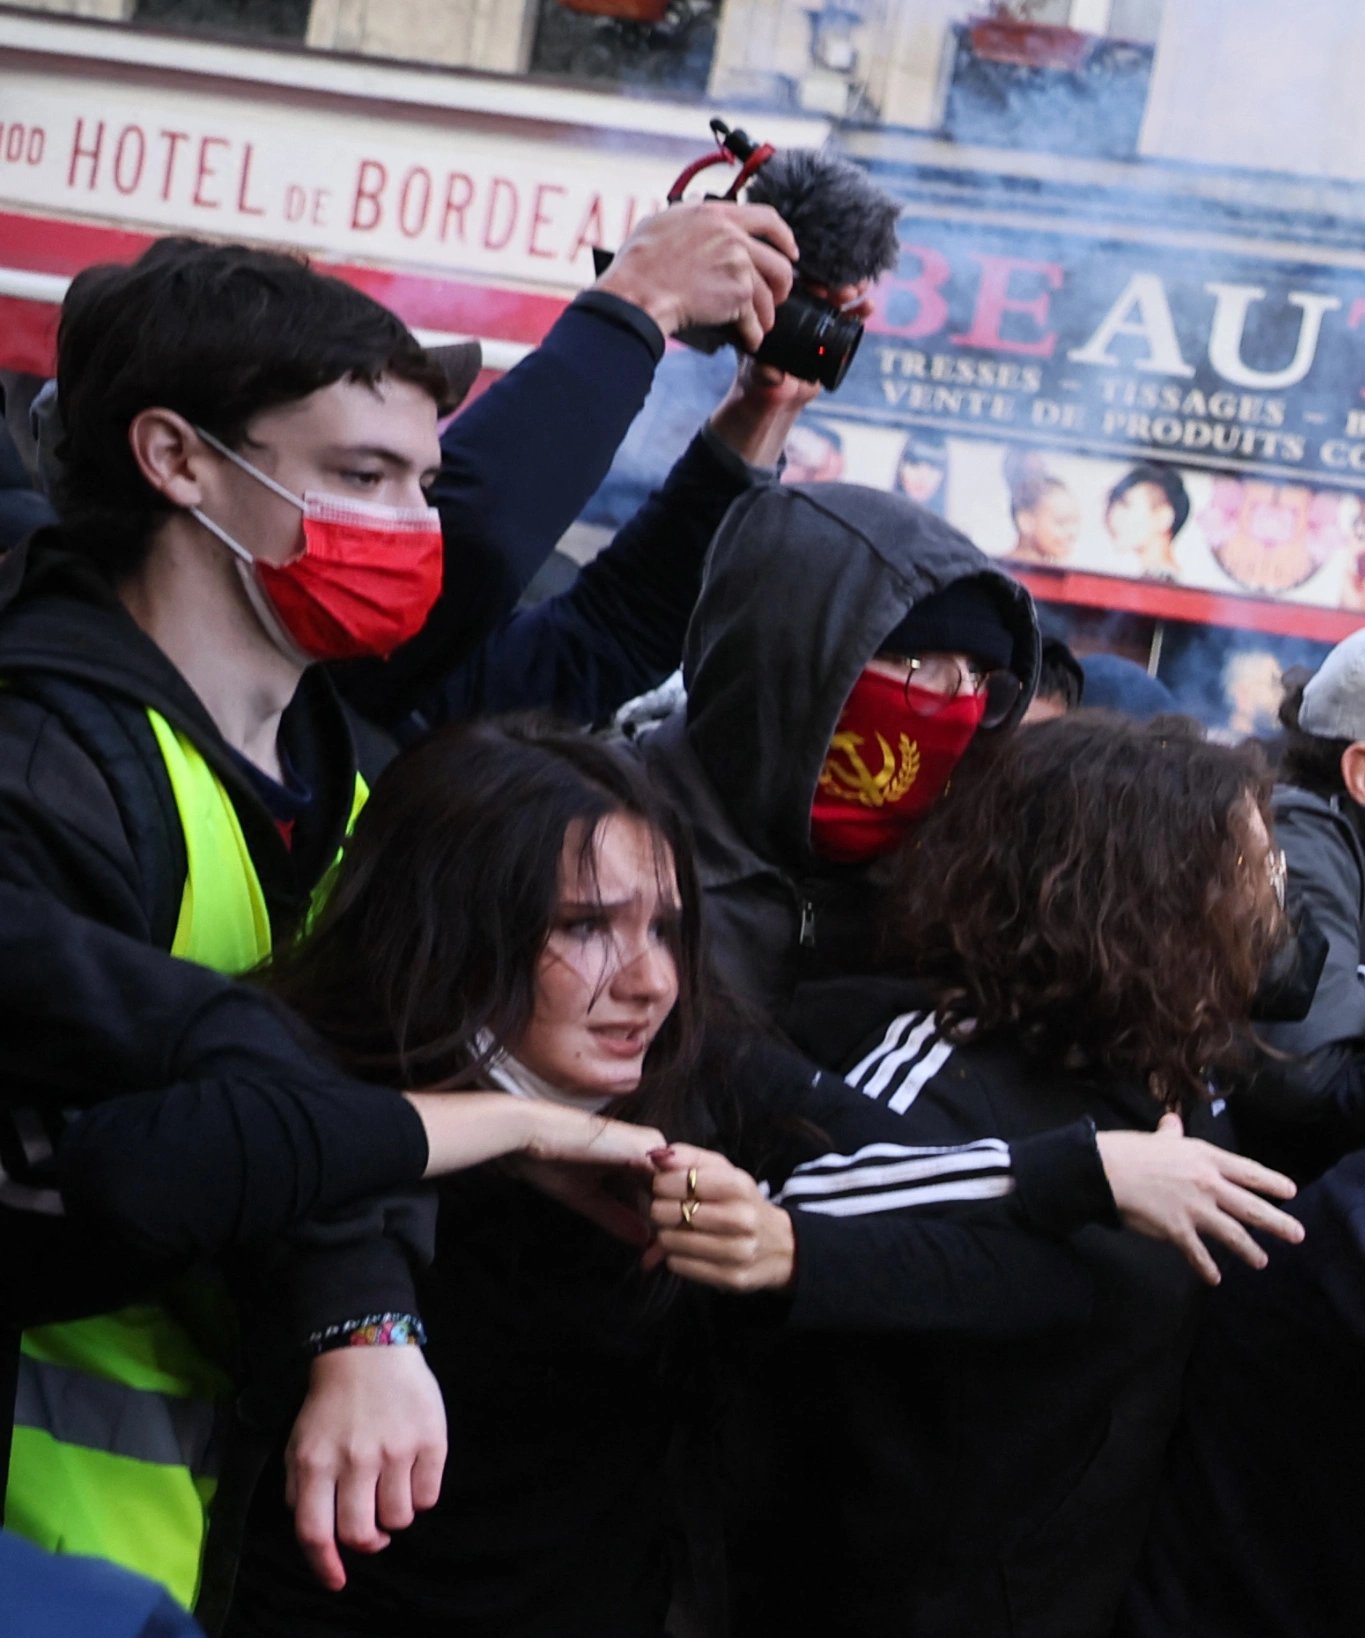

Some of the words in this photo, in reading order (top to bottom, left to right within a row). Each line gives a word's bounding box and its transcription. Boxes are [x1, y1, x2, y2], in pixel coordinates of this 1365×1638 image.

[66, 115, 266, 216] HOTEL
[282, 183, 331, 227] DE
[876, 347, 1041, 392] TRESSES
[1101, 376, 1287, 427] TISSAGES
[881, 379, 1016, 420] VENTE
[1031, 399, 1089, 430] DE
[1101, 410, 1305, 461] PRODUITS
